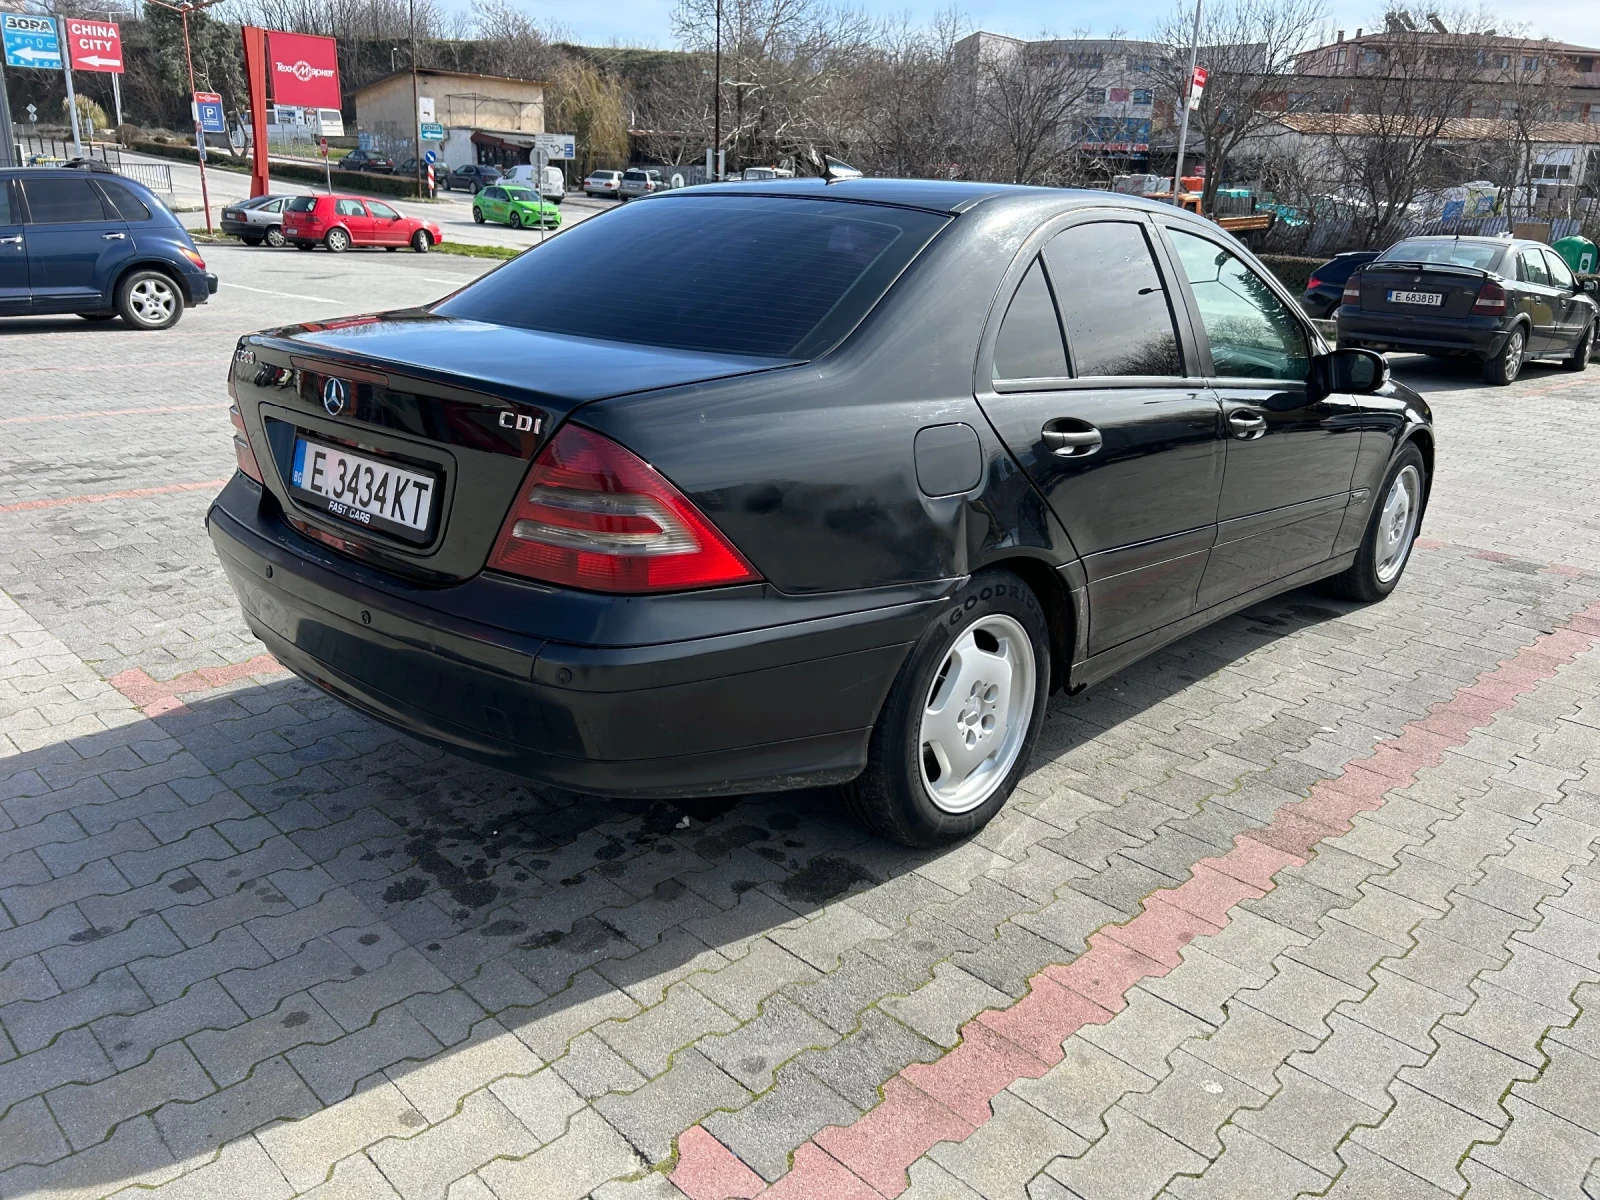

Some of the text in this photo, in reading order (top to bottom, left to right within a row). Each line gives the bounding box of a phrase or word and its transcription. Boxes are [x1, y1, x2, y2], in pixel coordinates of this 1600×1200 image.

[71, 24, 117, 38] CHINA
[79, 38, 112, 51] CITY
[499, 411, 541, 434] CDI
[293, 470, 302, 483] BG
[328, 500, 371, 524] FAST CARS
